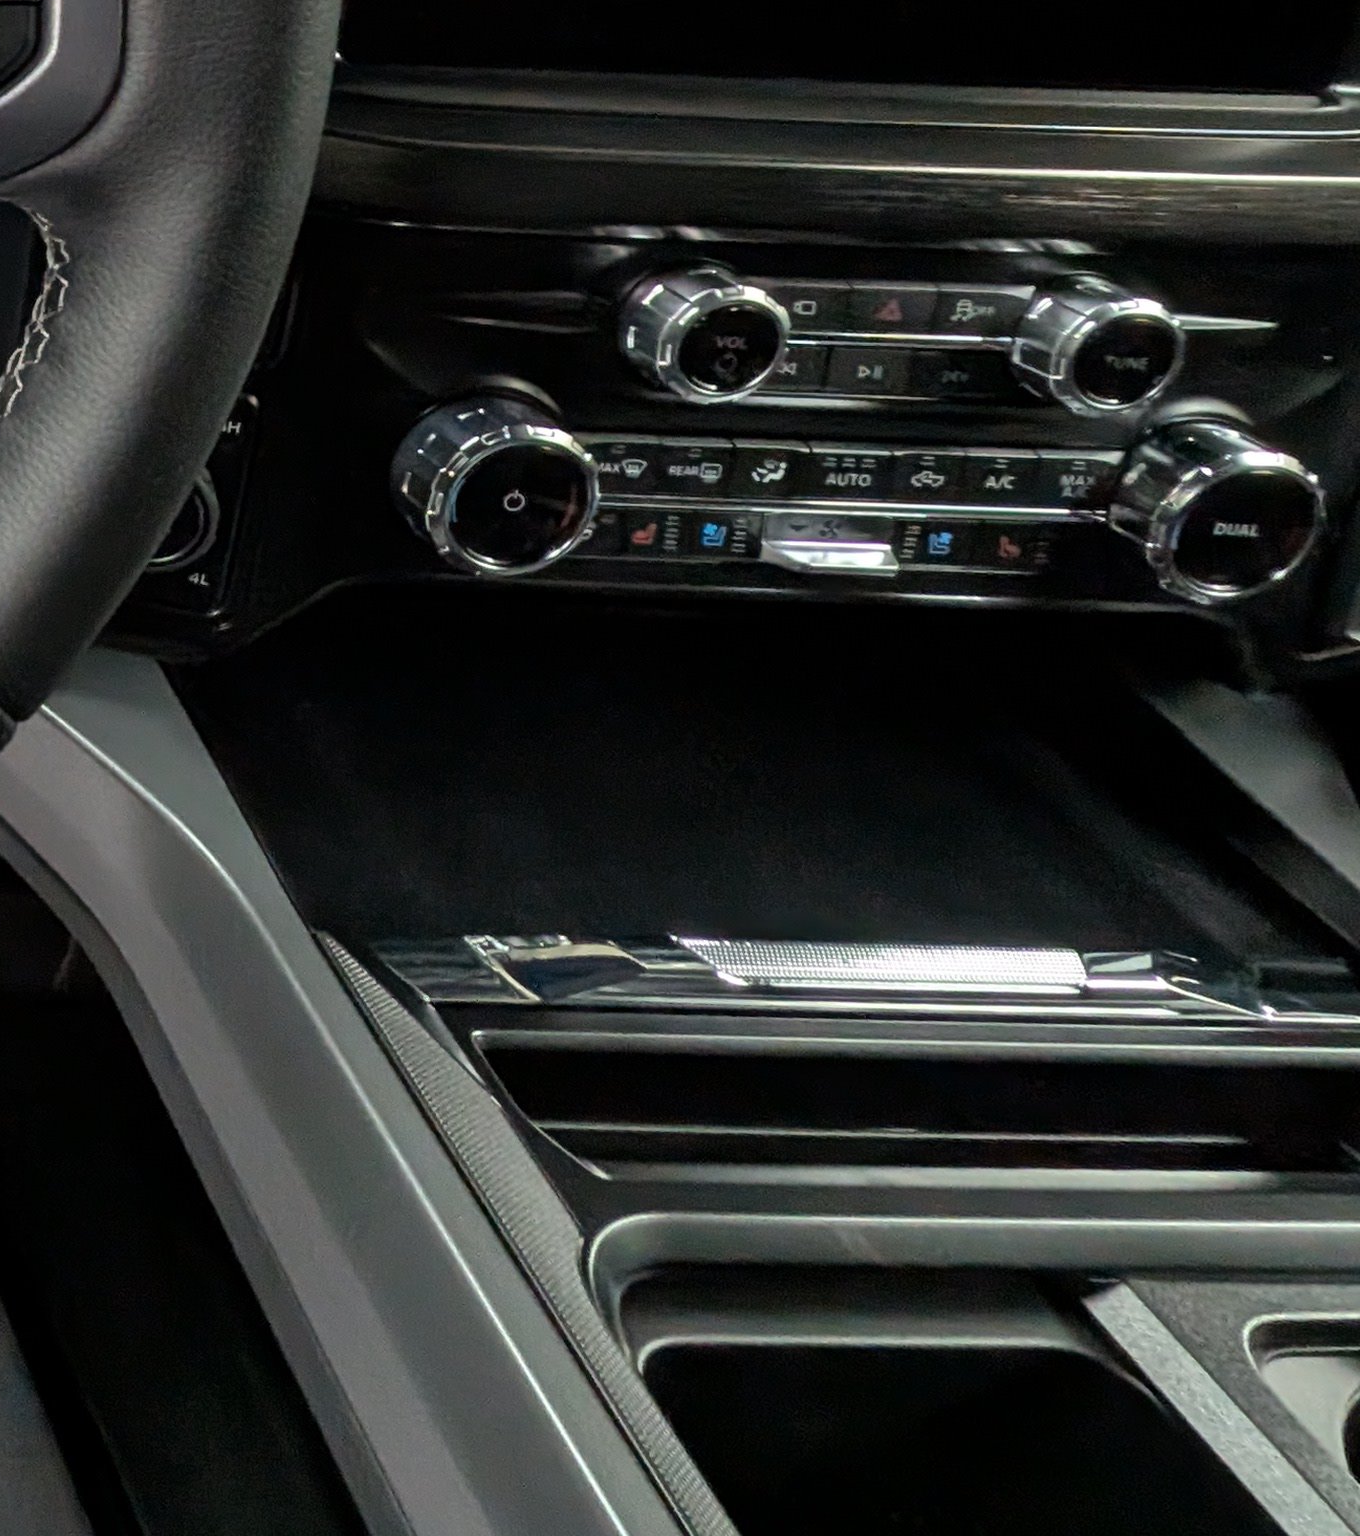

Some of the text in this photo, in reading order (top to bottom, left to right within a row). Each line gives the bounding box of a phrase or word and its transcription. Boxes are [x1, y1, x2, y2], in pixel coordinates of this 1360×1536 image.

[717, 335, 748, 350] VOL
[668, 465, 700, 477] REAR
[825, 472, 873, 488] AUTO
[985, 474, 1016, 490] A/C
[1213, 522, 1260, 539] DUAL
[188, 572, 210, 586] 4L
